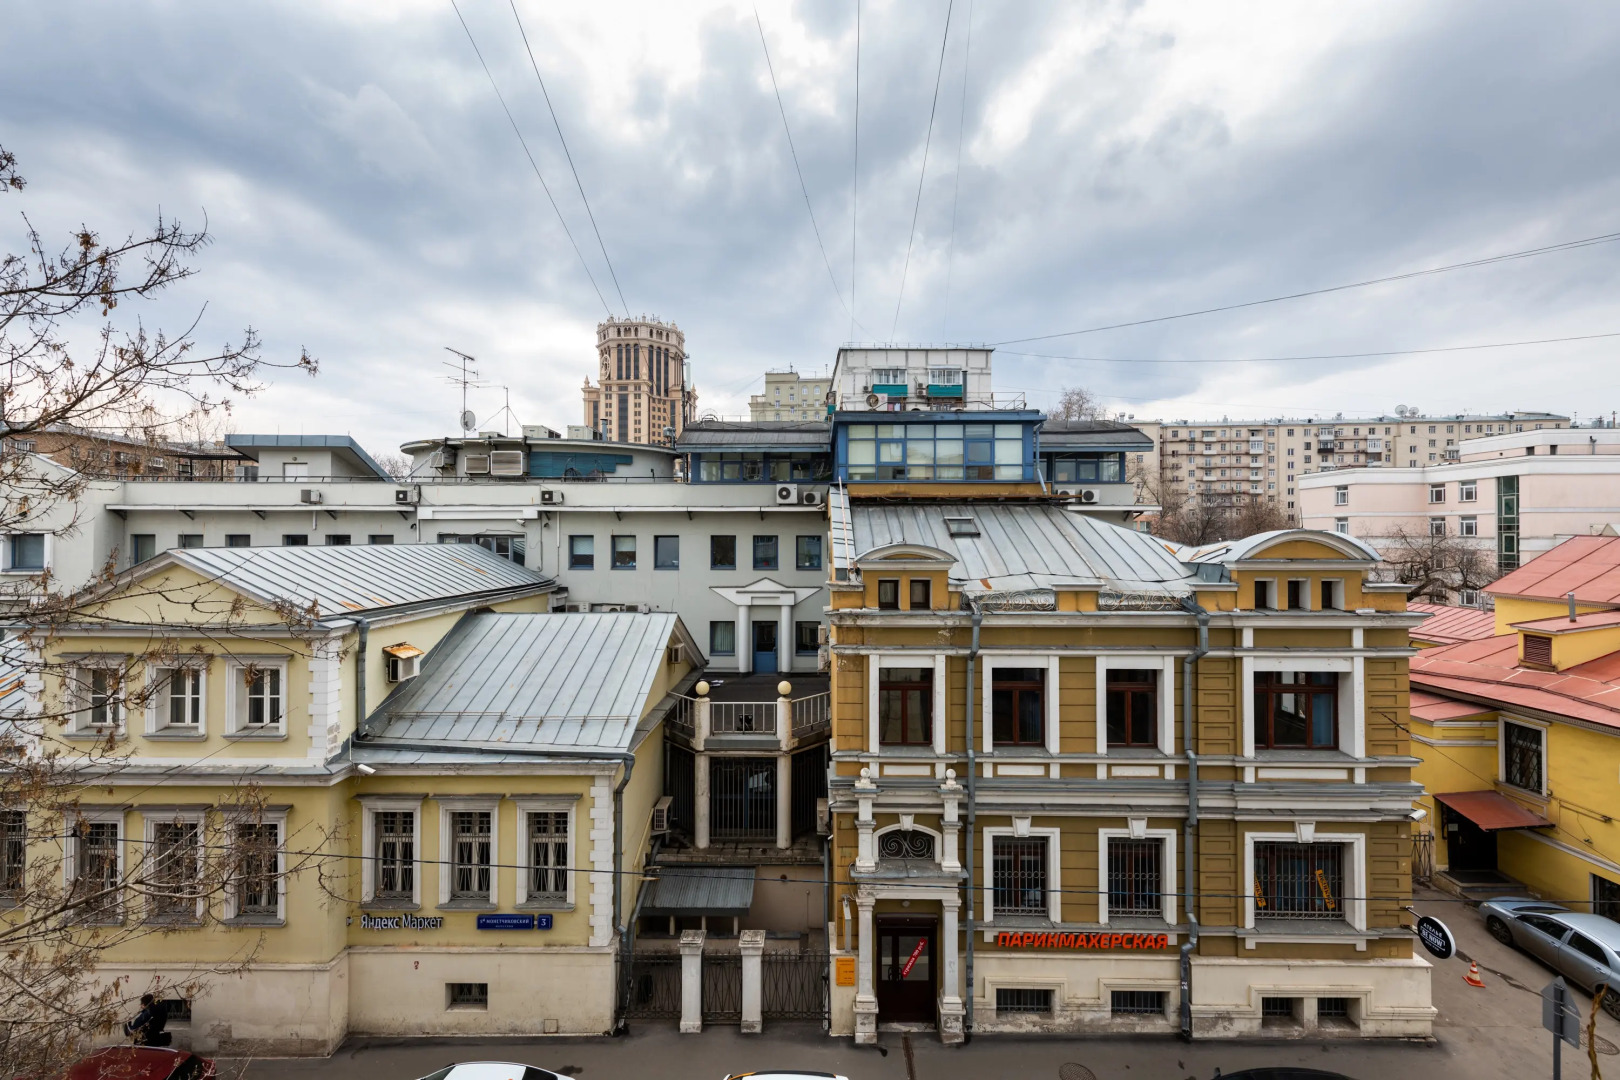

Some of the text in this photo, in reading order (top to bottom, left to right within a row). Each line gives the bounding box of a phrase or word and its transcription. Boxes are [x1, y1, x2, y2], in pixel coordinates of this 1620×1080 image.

[361, 913, 443, 931] Яндекс Маркет
[541, 918, 547, 927] 3
[998, 931, 1168, 949] ПАРИКМАХЕРСКАЯ
[1429, 934, 1443, 947] NOW
